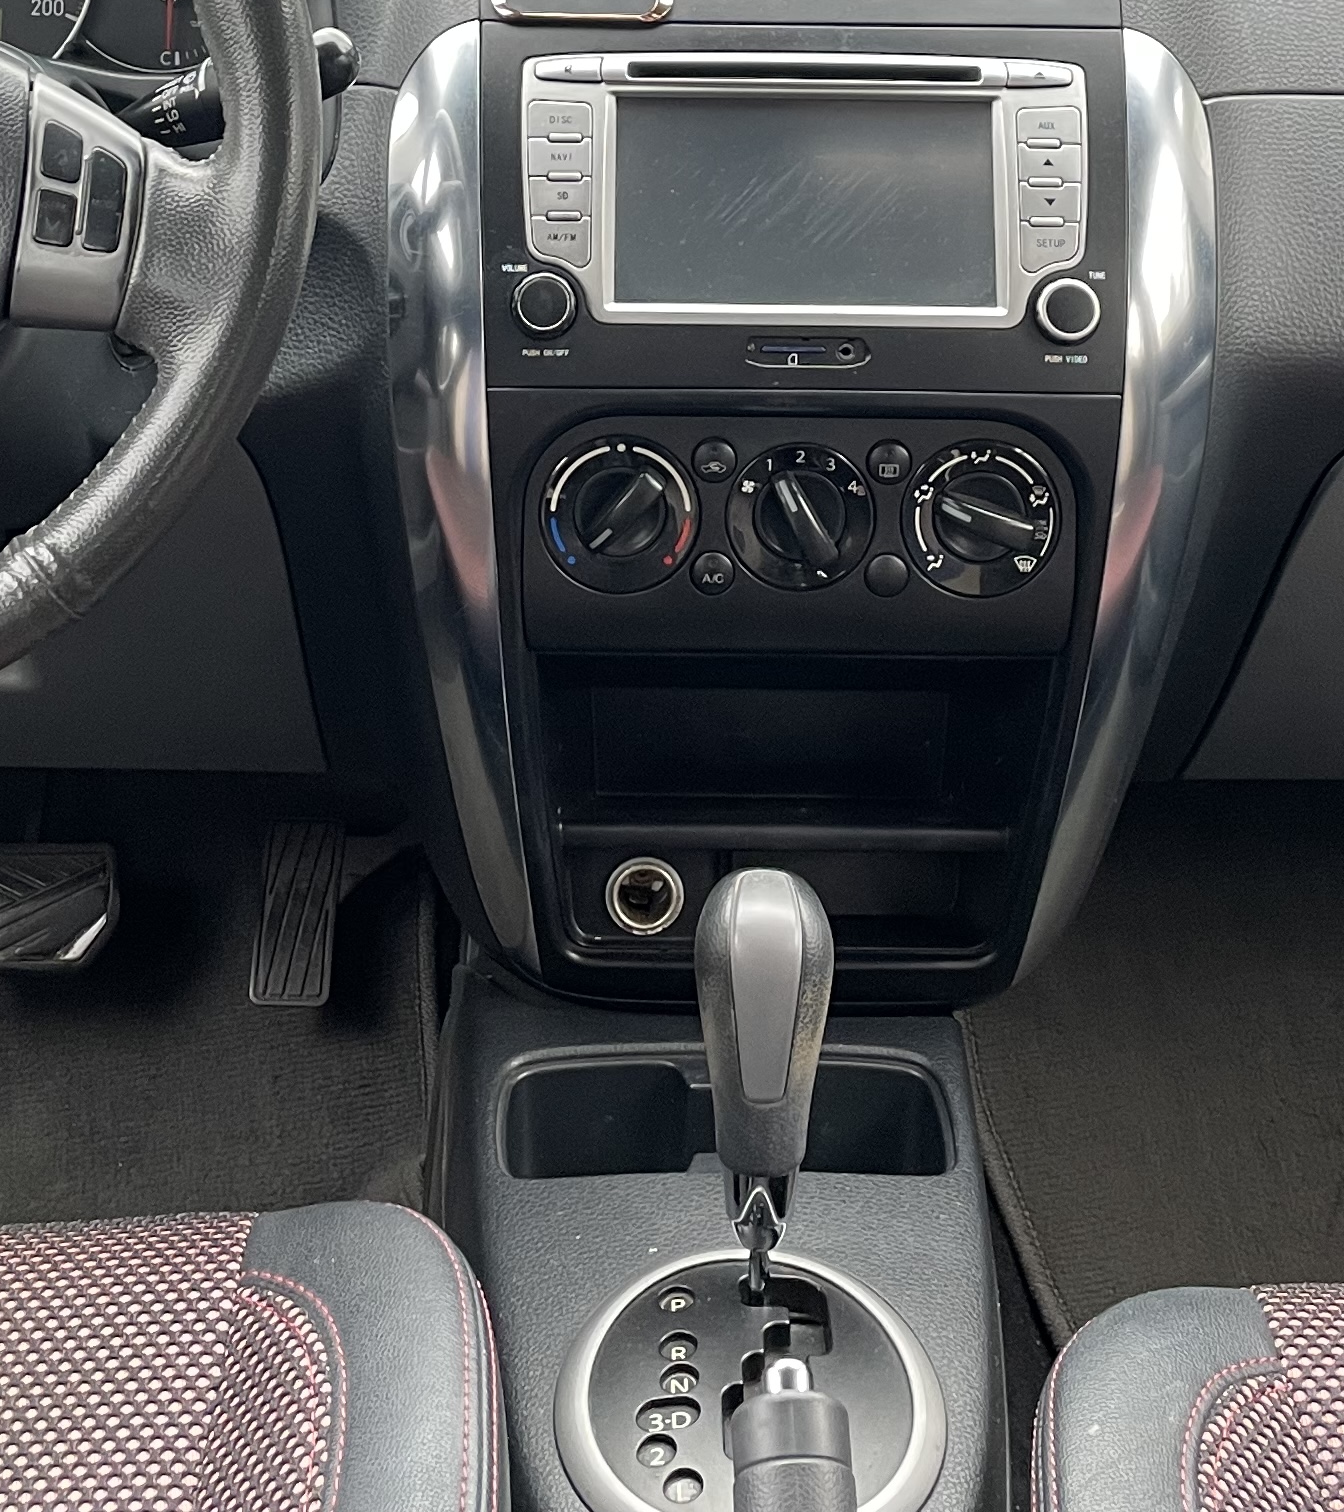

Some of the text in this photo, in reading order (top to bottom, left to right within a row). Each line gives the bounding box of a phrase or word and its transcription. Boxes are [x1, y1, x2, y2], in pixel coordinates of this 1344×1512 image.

[160, 51, 171, 66] C
[549, 115, 573, 125] DISC
[1038, 121, 1055, 130] AUX
[550, 153, 573, 161] NAVI
[557, 191, 569, 200] SD
[547, 233, 577, 241] AM/FM
[1036, 238, 1066, 248] SETUP
[1066, 355, 1088, 364] VIDEO
[795, 450, 806, 463] 2
[766, 458, 773, 472] 1
[826, 457, 836, 472] 3
[847, 480, 858, 494] 4
[702, 573, 725, 584] A/C
[670, 1299, 686, 1312] P
[671, 1346, 687, 1361] R
[670, 1377, 689, 1394] N
[649, 1447, 665, 1467] 2
[676, 1487, 691, 1502] L
